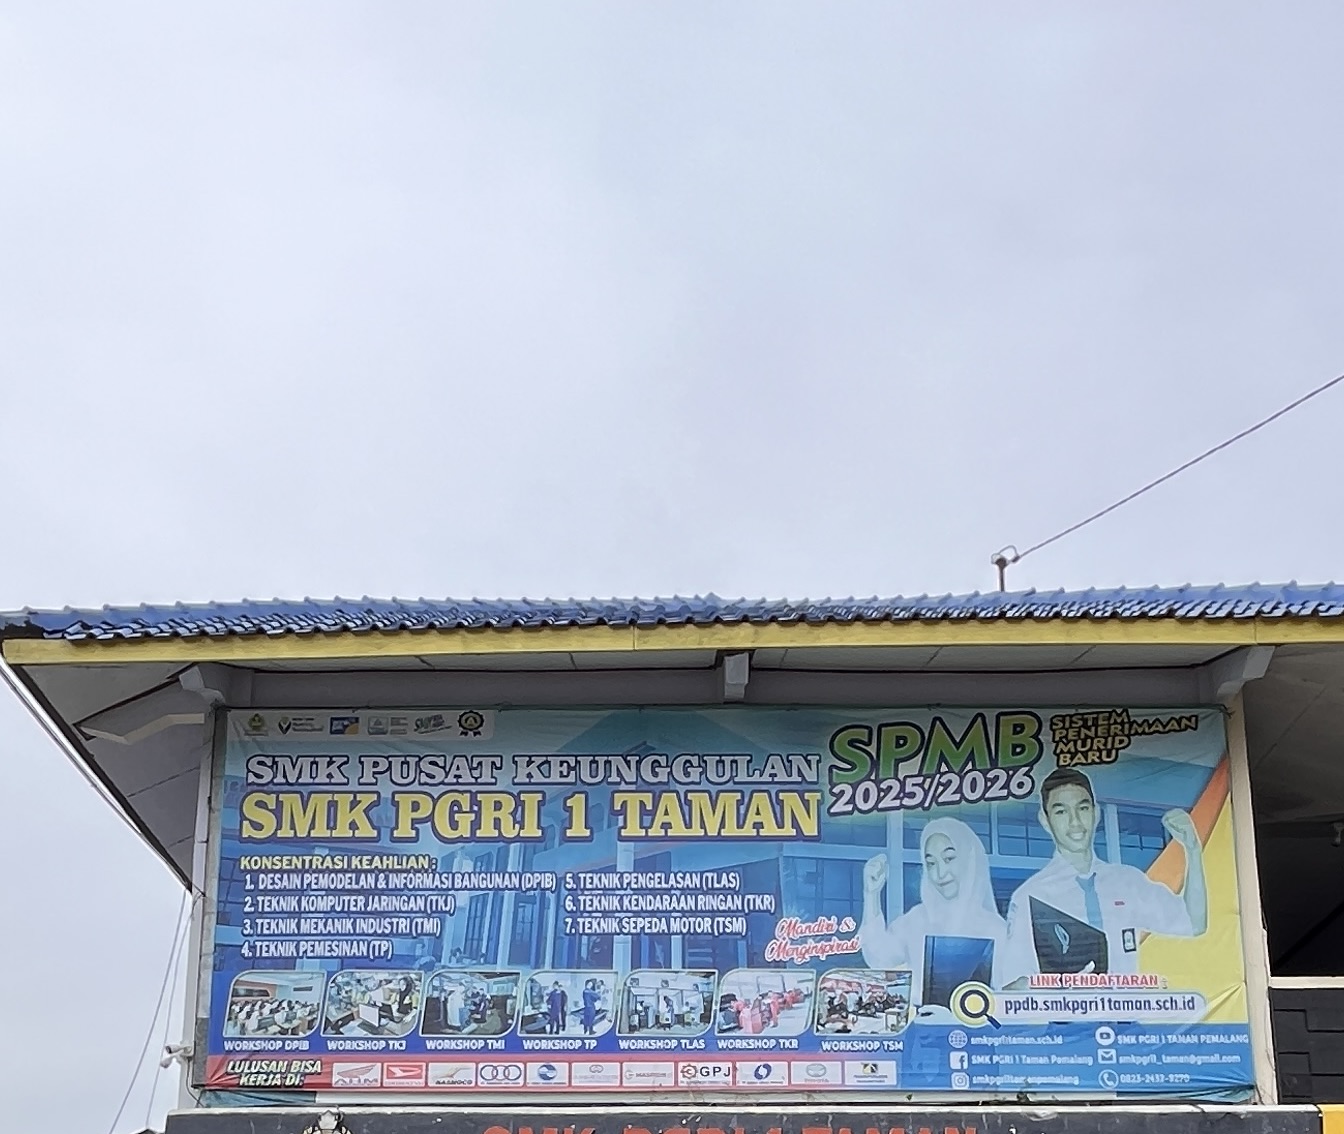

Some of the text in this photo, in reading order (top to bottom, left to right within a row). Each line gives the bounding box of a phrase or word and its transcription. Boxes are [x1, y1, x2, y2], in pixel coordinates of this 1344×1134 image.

[1051, 711, 1129, 729] SISTEM
[1053, 716, 1199, 742] PENERIMAAN
[830, 712, 1041, 785] SPMB
[1056, 736, 1129, 754] MURID
[1058, 750, 1117, 766] BARU
[247, 755, 821, 785] SMK PUSAT KEUNGGULAN
[828, 767, 1034, 814] 2025/2026
[241, 792, 822, 838] SMK PGRI 1 TAMAN
[240, 855, 348, 870] KONSENTRASI
[351, 855, 430, 870] KEAHLIAN
[244, 873, 556, 890] 1. DESAIN PEMODELAN & INFORMASI BANGUNAN (DPIB)
[565, 872, 740, 890] 5. TEKNIK PENGELASAN (TLAS)
[244, 895, 455, 914] 2. TEKNIK KOMPUTER JARINGAN (TKJ)
[565, 895, 775, 913] 6. TEKNIK KENDARAAN RINGAN (TKR)
[243, 918, 441, 936] 3. TEKNIK MEKANIK INDUSTRI (TMI)
[565, 917, 746, 935] 7. TEKNIK SEPEDA MOTOR (TSM)
[776, 916, 837, 939] Mandiri
[241, 940, 393, 959] 4. TEKNIK PEMESINAN (TP)
[765, 935, 860, 963] Menginspirasi
[1029, 974, 1060, 987] LINK
[1063, 974, 1159, 987] PENDAFTARAN
[1005, 996, 1196, 1015] ppdb.smkpgri1taman.sch.id
[223, 1040, 309, 1050] WORKSHOP DPIB
[327, 1040, 386, 1050] WORKSHOP
[426, 1040, 505, 1050] WORKSHOP TMI
[523, 1040, 597, 1050] WORKSHOP TP
[618, 1039, 705, 1050] WORKSHOP TLAS
[717, 1039, 798, 1050] WORKSHOP TKR
[821, 1041, 903, 1051] WORKSHOP TSM
[227, 1060, 322, 1073] LULUSAN BISA
[239, 1074, 282, 1086] KERJA
